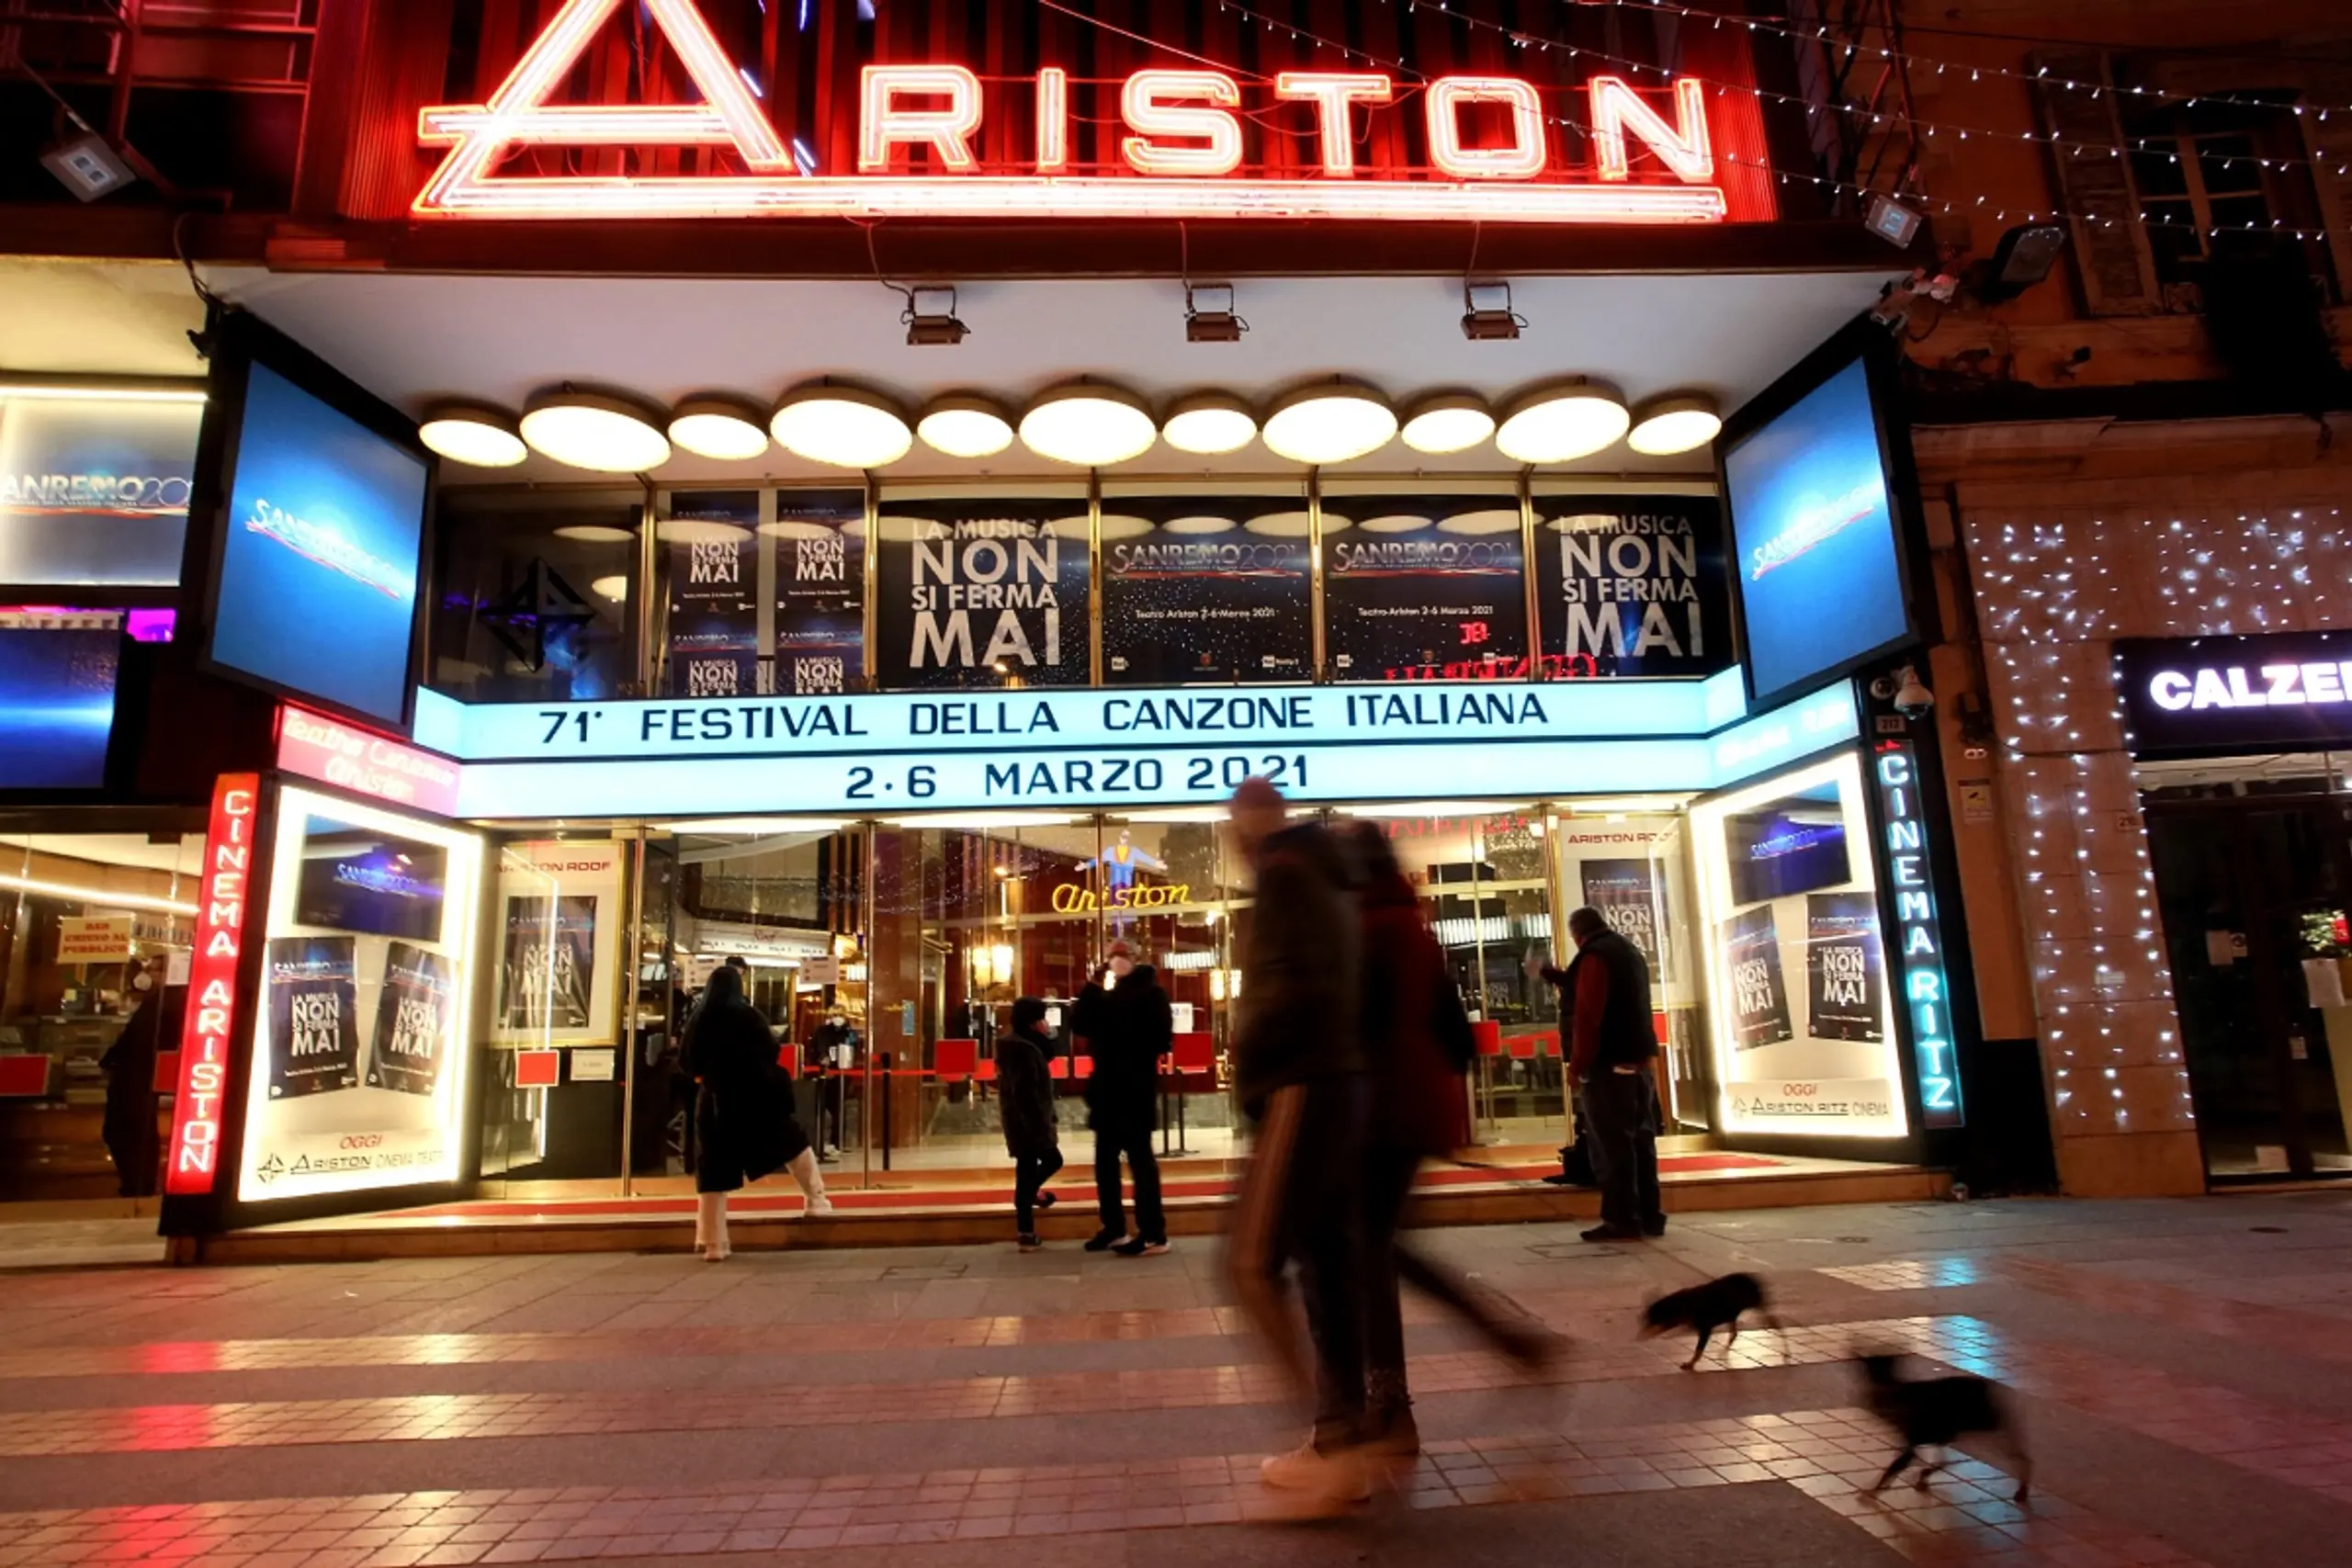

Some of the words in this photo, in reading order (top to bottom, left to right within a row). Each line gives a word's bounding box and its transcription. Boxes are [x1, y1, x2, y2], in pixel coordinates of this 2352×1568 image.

[413, 0, 1729, 219] ARISTON
[912, 521, 944, 540] LA
[954, 519, 1057, 539] MUSICA
[1599, 515, 1692, 535] MUSICA
[692, 539, 739, 558] NON
[797, 538, 844, 555] NON
[1561, 535, 1697, 579] NON
[690, 563, 739, 583] MAI
[796, 561, 844, 581] MAI
[912, 538, 1058, 585] NON
[911, 585, 936, 610] SI
[948, 584, 1058, 610] FERMA
[1563, 578, 1587, 603] SI
[1597, 578, 1699, 603] FERMA
[910, 607, 1060, 668] MAI
[1566, 602, 1703, 658] MAI
[690, 665, 738, 682] NON
[796, 663, 843, 680] NON
[641, 705, 869, 741] FESTIVAL
[909, 701, 1060, 736] DELLA
[1102, 695, 1314, 731] CANZONE
[1346, 693, 1549, 727] ITALIANA
[985, 758, 1164, 796] MARZO
[1187, 753, 1309, 790] 2021
[1568, 833, 1634, 844] ARISTON
[205, 790, 251, 959] CINEMA
[566, 862, 611, 872] ROOF
[1605, 910, 1651, 927] NON
[1880, 755, 1934, 954] CINEMA
[1911, 971, 1953, 1108] RITZ
[1823, 954, 1865, 972] NON
[1823, 980, 1866, 1005] MAI
[292, 999, 340, 1023] NON
[291, 1028, 341, 1057] MAI
[390, 1031, 434, 1059] MAI
[179, 978, 232, 1173] ARISTON
[1782, 1083, 1817, 1097] OGGI
[1750, 1097, 1814, 1114] ARISTON
[1818, 1102, 1849, 1112] RITZ
[339, 1134, 382, 1149] OGGI
[289, 1153, 372, 1175] ARISTON
